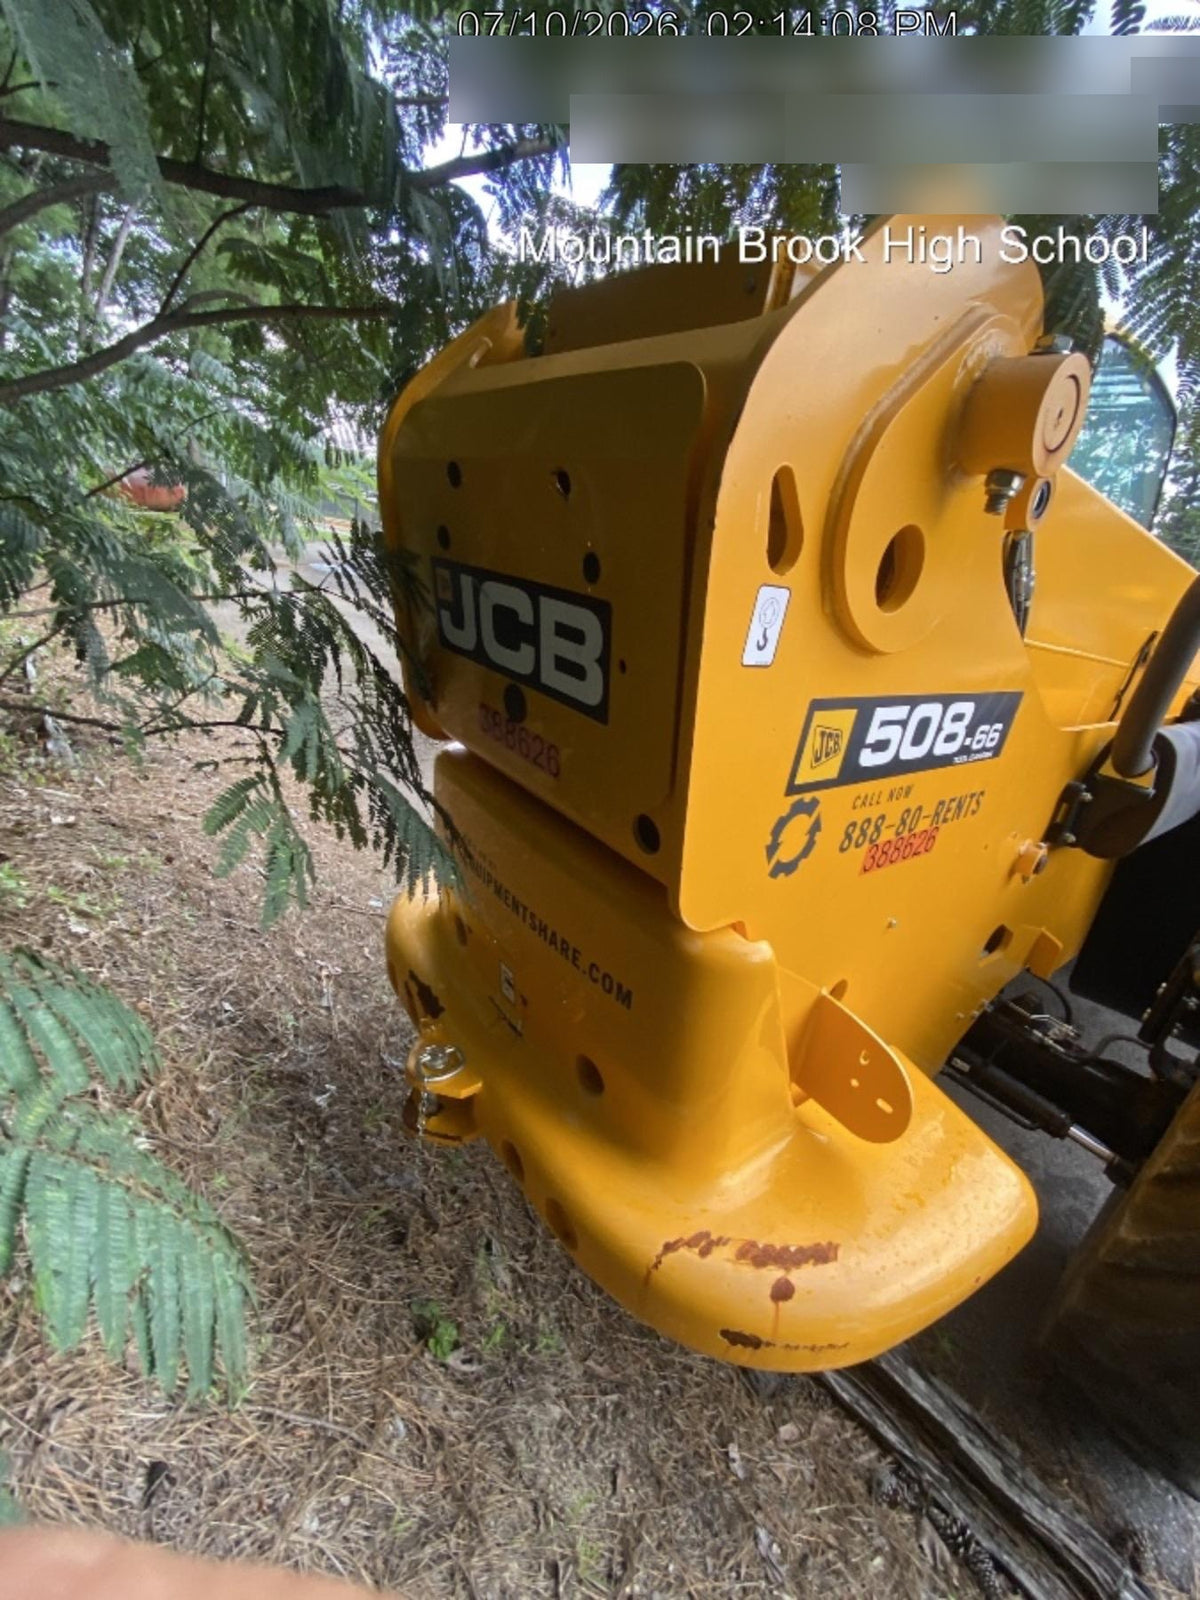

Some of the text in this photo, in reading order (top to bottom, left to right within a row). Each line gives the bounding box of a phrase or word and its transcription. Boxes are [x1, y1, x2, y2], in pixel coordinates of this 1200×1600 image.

[439, 572, 604, 707] JCB
[813, 729, 842, 765] JCB
[852, 784, 915, 810] CALL NOW
[838, 790, 986, 854] 888-80-RENTS
[862, 826, 940, 874] 388626
